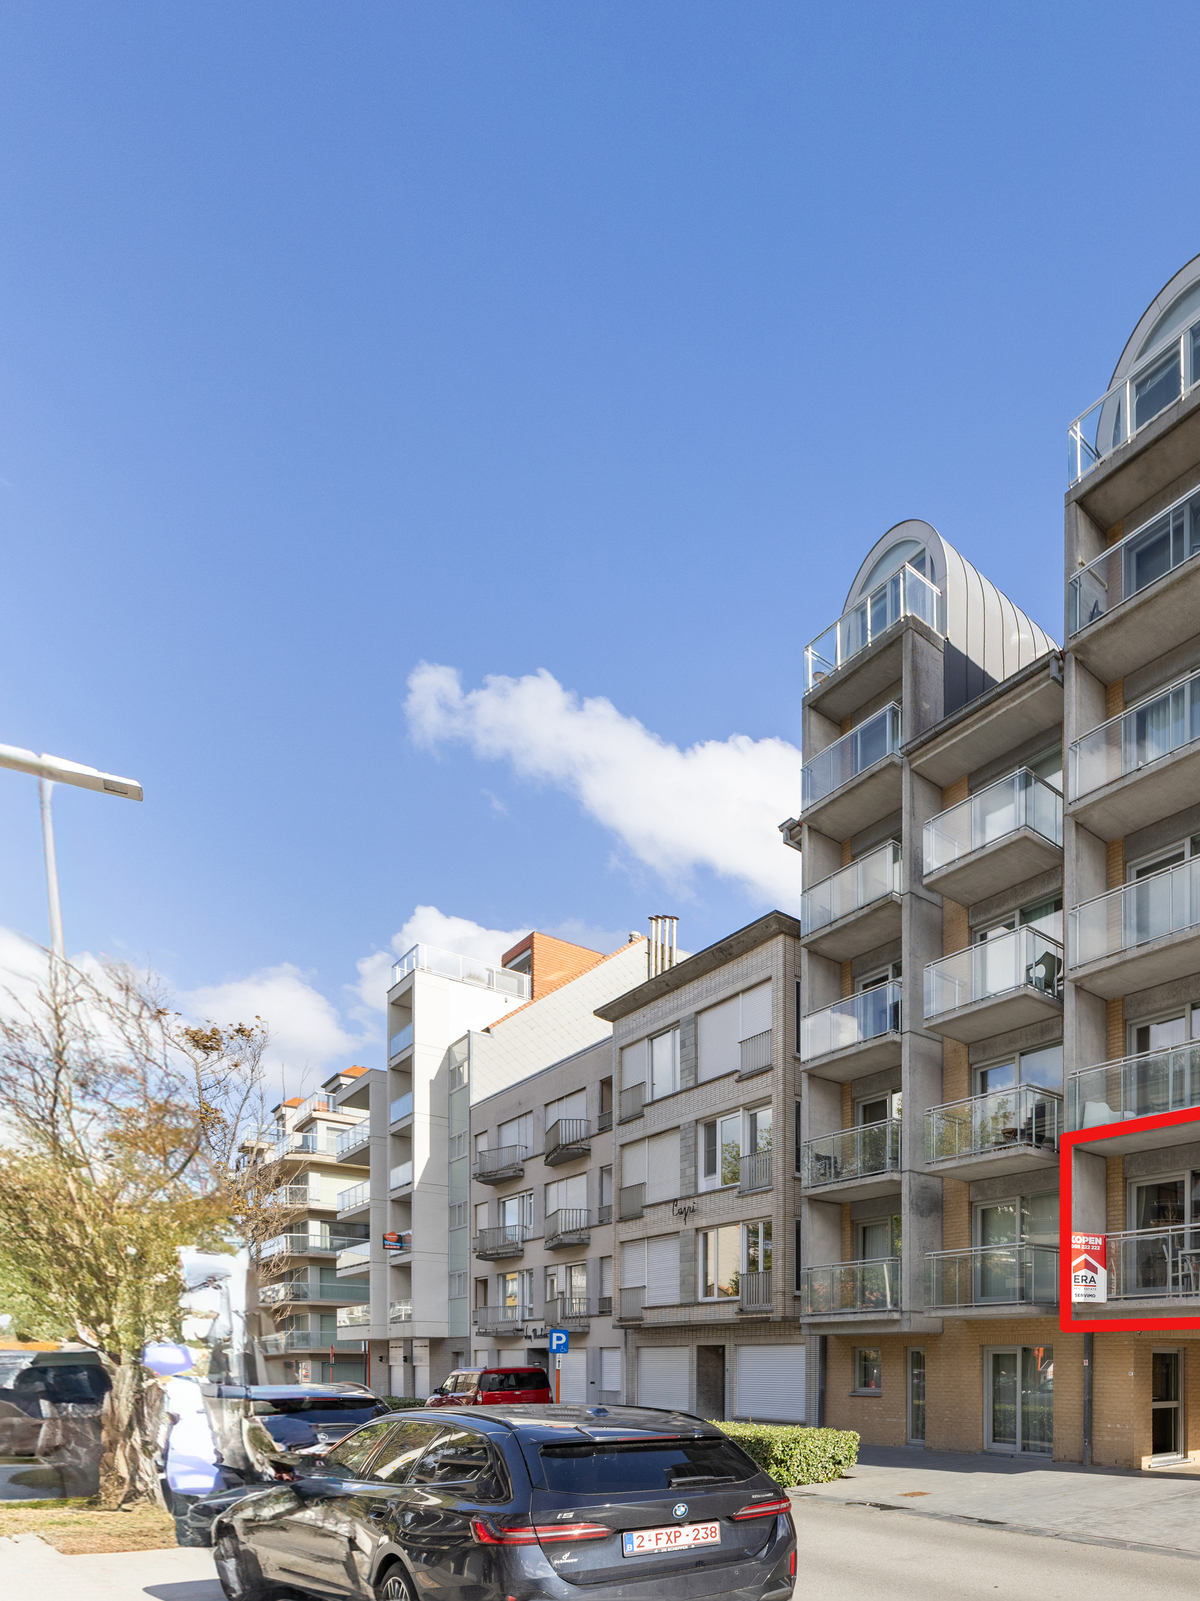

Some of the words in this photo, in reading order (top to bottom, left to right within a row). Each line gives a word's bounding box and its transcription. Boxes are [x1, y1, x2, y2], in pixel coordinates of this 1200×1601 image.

[1074, 1275, 1097, 1284] ERA
[552, 1332, 567, 1350] P
[636, 1526, 718, 1549] 2-FXP-238
